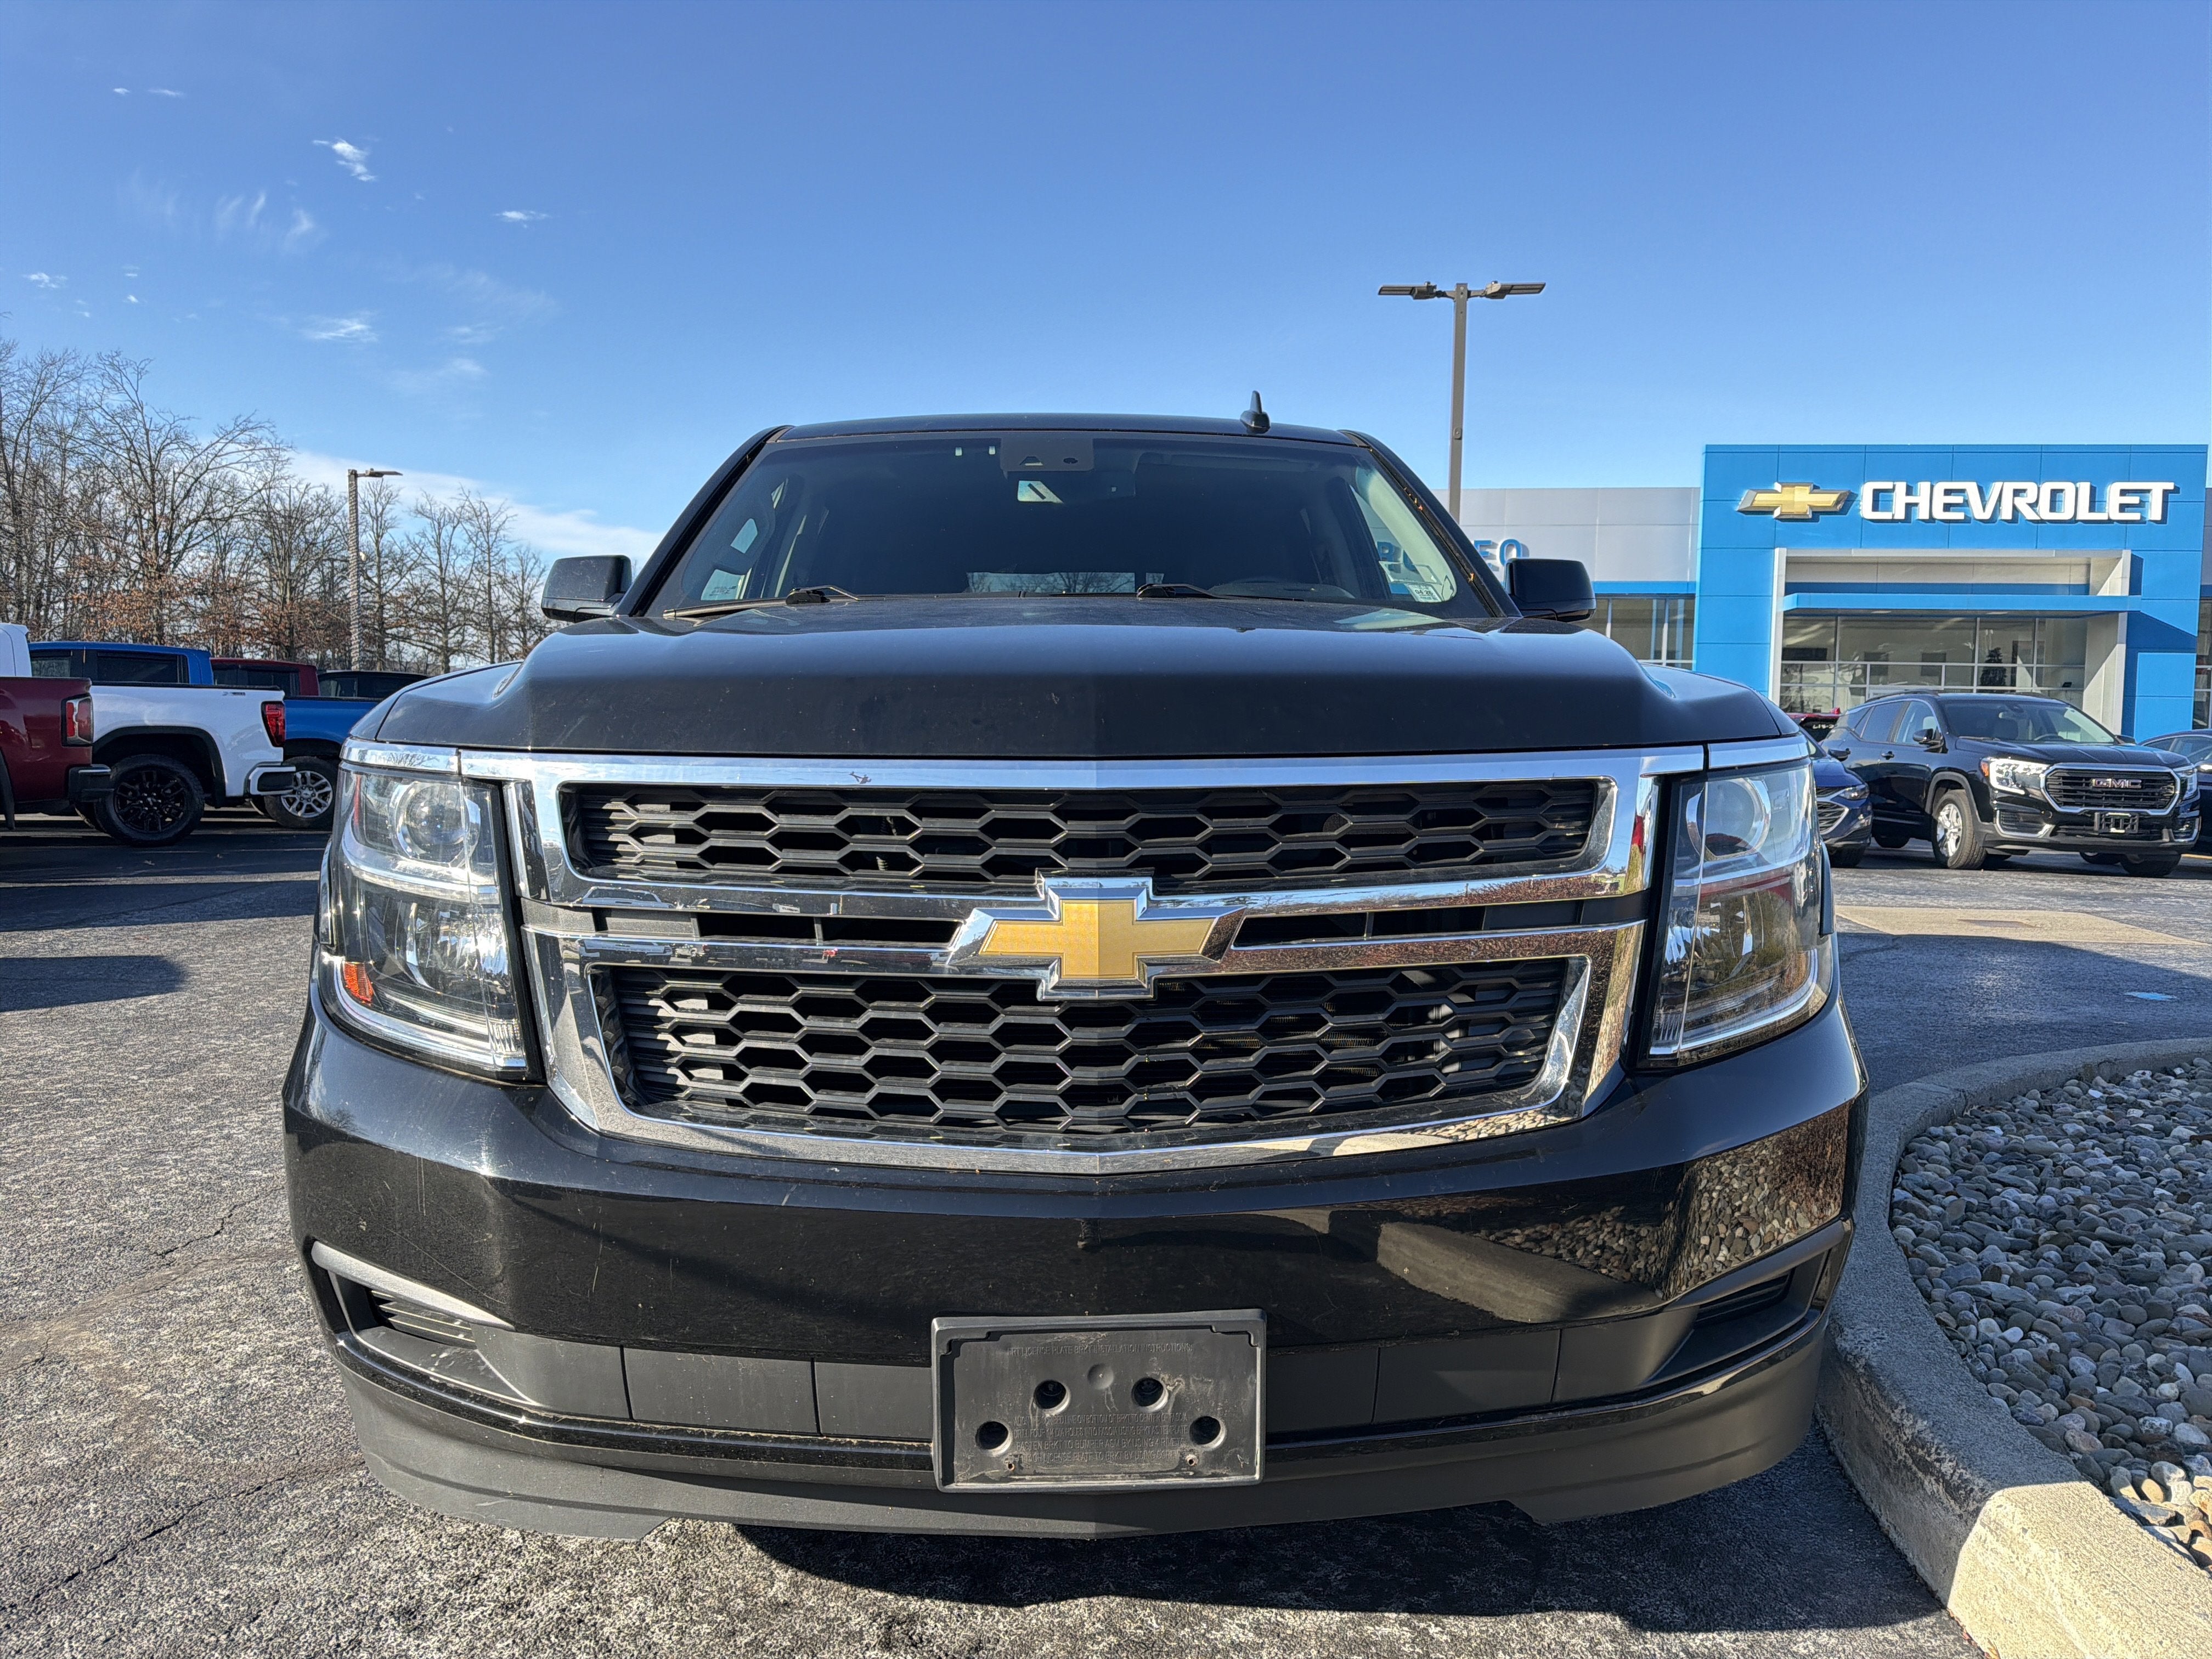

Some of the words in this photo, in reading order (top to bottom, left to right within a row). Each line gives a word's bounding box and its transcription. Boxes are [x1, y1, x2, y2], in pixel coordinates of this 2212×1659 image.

[1860, 481, 2175, 521] CHEVROLET
[2092, 778, 2142, 788] GMC
[1022, 1346, 1051, 1357] LICENSE
[1052, 1346, 1073, 1355] PLATE
[1074, 1345, 1093, 1354] BRKT
[1093, 1344, 1139, 1353] INSTALLATION
[1065, 1415, 1076, 1424] LINE
[1077, 1414, 1085, 1424] ON
[1086, 1414, 1108, 1424] BOTTOM
[1108, 1414, 1116, 1423] OF
[1117, 1413, 1131, 1423] BRKT
[1131, 1413, 1139, 1423] TO
[1139, 1413, 1160, 1422] CENTER
[1161, 1413, 1169, 1422] OF
[1170, 1412, 1188, 1422] FASCIA
[1014, 1429, 1028, 1438] DRILL
[1030, 1428, 1045, 1437] FOUR
[1065, 1427, 1084, 1436] HOLES
[1085, 1427, 1098, 1436] INTO
[1098, 1426, 1118, 1436] FASCIA
[1118, 1426, 1136, 1435] USING
[1136, 1426, 1151, 1435] BRKT
[1152, 1425, 1159, 1435] AS
[1160, 1425, 1188, 1435] TEMPLATE
[1017, 1441, 1042, 1451] FASTEN
[1044, 1440, 1062, 1450] BRKT
[1064, 1440, 1073, 1449] TO
[1075, 1440, 1104, 1449] BUMPER
[1105, 1438, 1120, 1448] ASM
[1121, 1438, 1131, 1448] BY
[1132, 1438, 1154, 1447] USING
[1154, 1438, 1159, 1447] 4
[1161, 1437, 1184, 1447] RIVETS
[1043, 1452, 1072, 1463] LICENSE
[1073, 1452, 1092, 1462] PLATE
[1094, 1452, 1104, 1461] TO
[1105, 1451, 1123, 1460] BRKT
[1125, 1451, 1133, 1460] BY
[1135, 1450, 1155, 1460] USING
